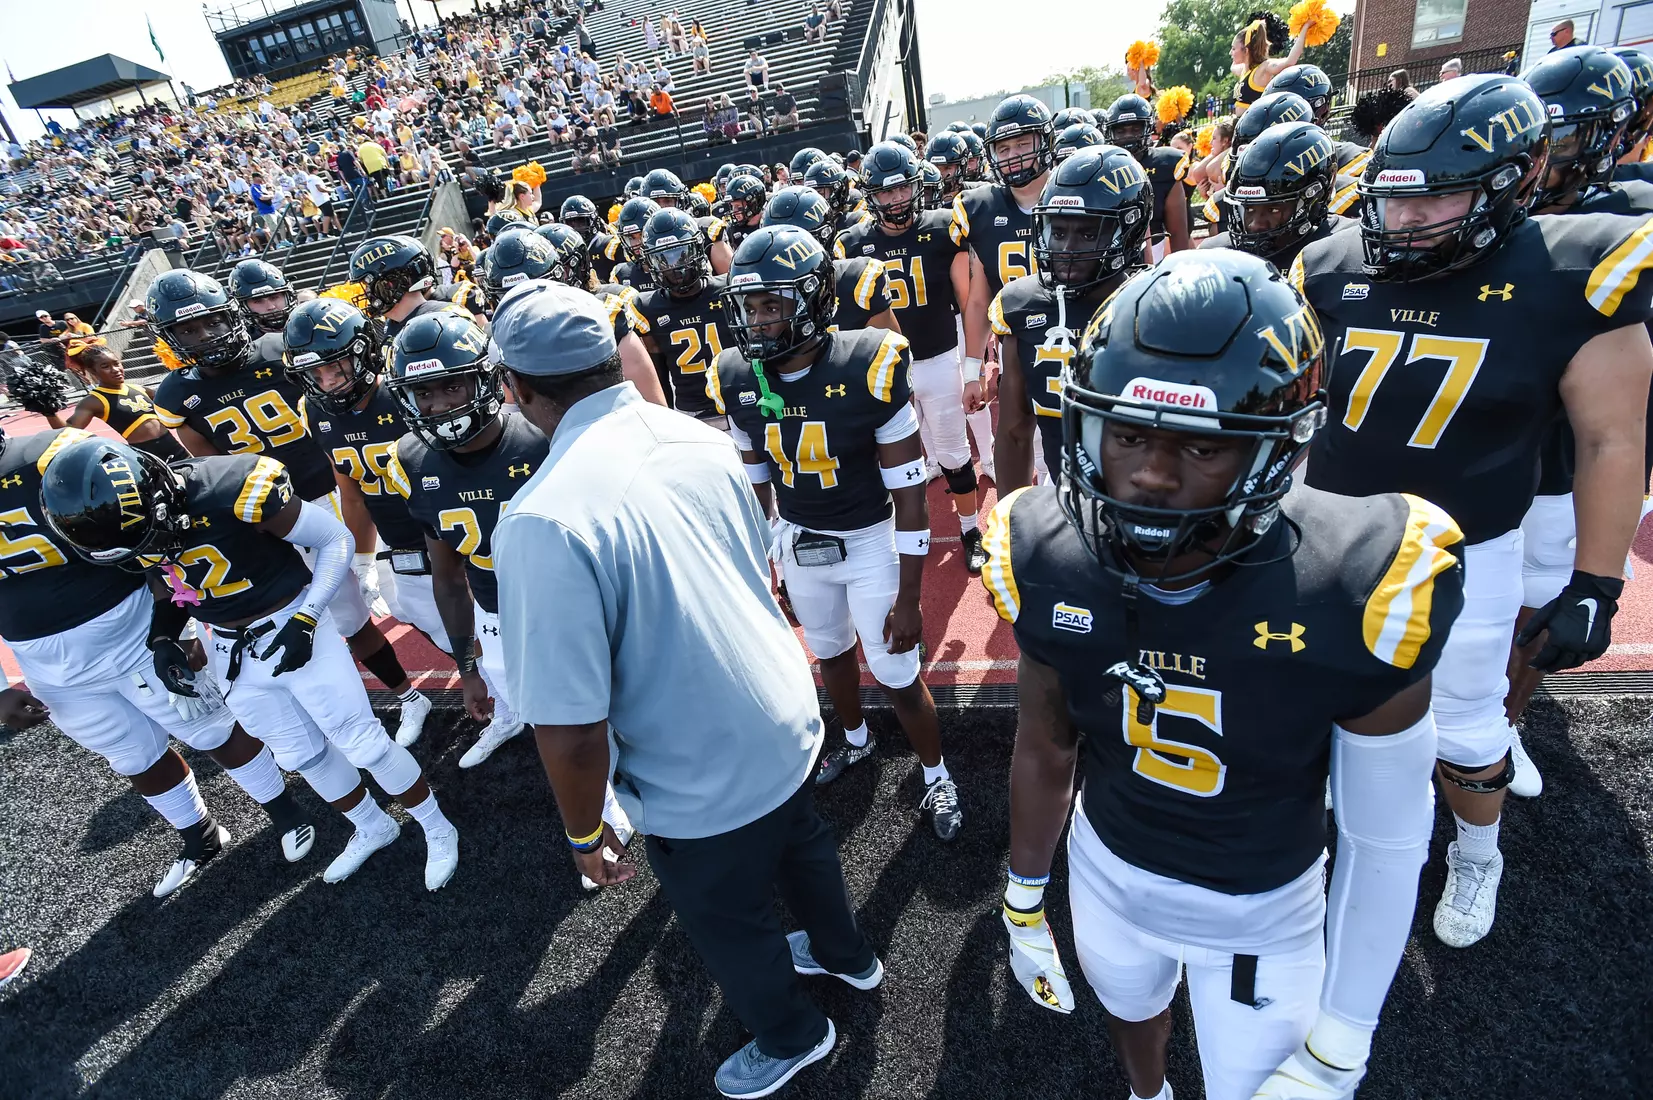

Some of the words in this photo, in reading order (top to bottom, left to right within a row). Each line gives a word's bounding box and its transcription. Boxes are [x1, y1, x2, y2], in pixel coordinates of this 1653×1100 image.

[1378, 173, 1416, 183] Riddell
[1237, 188, 1261, 196] Riddell
[354, 241, 397, 271] VILLE
[884, 247, 908, 258] VILLE
[638, 282, 655, 290] VILLE
[1344, 287, 1368, 296] PSAC
[177, 304, 202, 316] Riddell
[679, 315, 702, 327] VILLE
[1028, 316, 1045, 326] PSAC
[1389, 308, 1441, 328] VILLE
[669, 322, 723, 375] 21
[408, 362, 438, 373] Riddell
[1340, 326, 1491, 450] 77
[217, 388, 246, 406] VILLE
[740, 394, 756, 402] PSAC
[1132, 384, 1208, 408] Riddell
[782, 405, 808, 419] ILLE
[204, 389, 306, 455] 39
[343, 431, 369, 443] VILLE
[764, 420, 841, 490] 14
[423, 479, 439, 487] PSAC
[101, 457, 145, 531] VILLE
[458, 488, 495, 503] VILLE
[1133, 525, 1171, 539] Riddell
[1054, 610, 1090, 628] PSAC
[1122, 682, 1228, 798] 5
